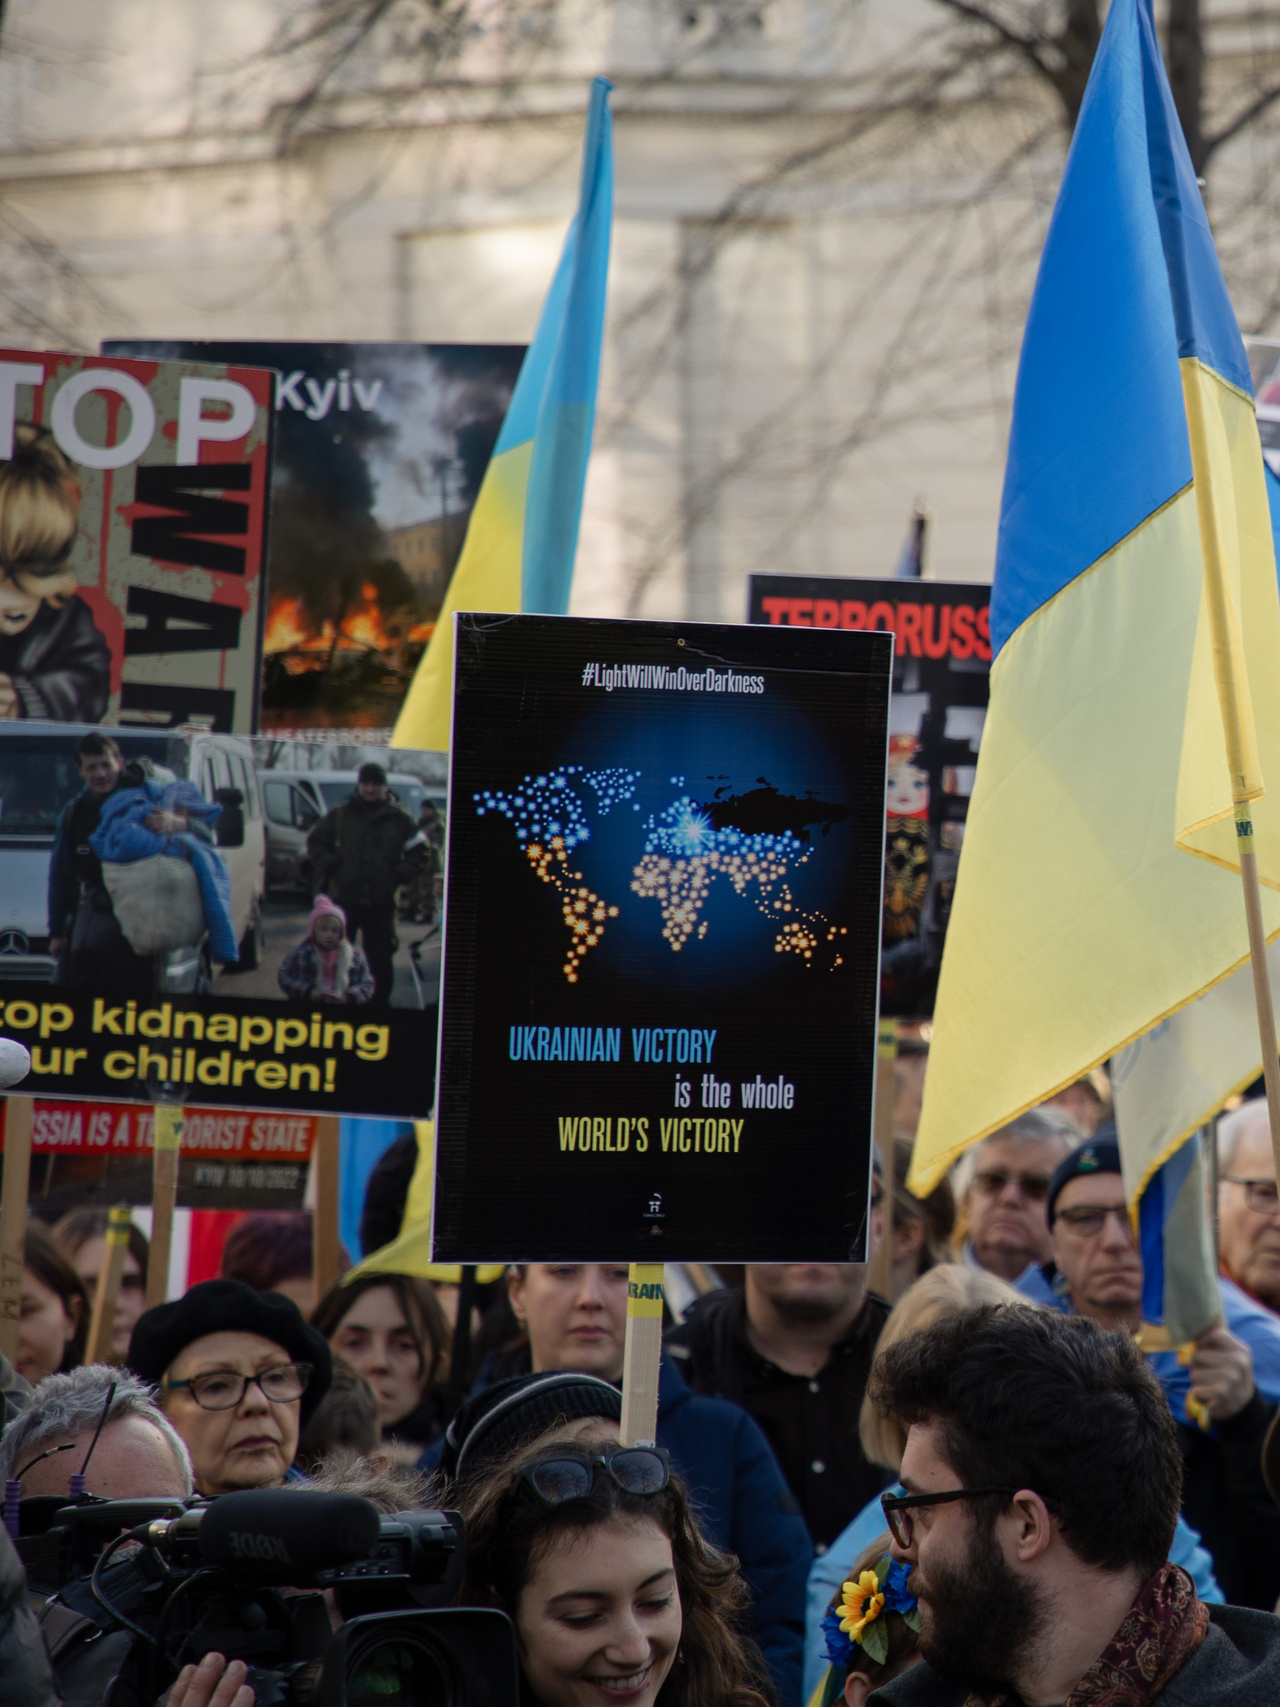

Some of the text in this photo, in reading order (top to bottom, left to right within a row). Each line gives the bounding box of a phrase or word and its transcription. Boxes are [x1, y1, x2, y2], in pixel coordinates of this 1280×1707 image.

[275, 370, 383, 420] Kyiv
[762, 597, 991, 660] TERRORUSS
[582, 663, 764, 693] #LightWillWinOverDarkness
[0, 998, 391, 1061] op kidnapping
[509, 1026, 717, 1064] UKRAINIAN VICTORY
[31, 1045, 338, 1093] ur children!
[675, 1074, 794, 1109] is the whole
[31, 1111, 82, 1147] SSIA
[87, 1112, 110, 1147] IS
[113, 1113, 129, 1148] A
[249, 1116, 312, 1152] STATE
[558, 1117, 745, 1152] WORLD'S VICTORY
